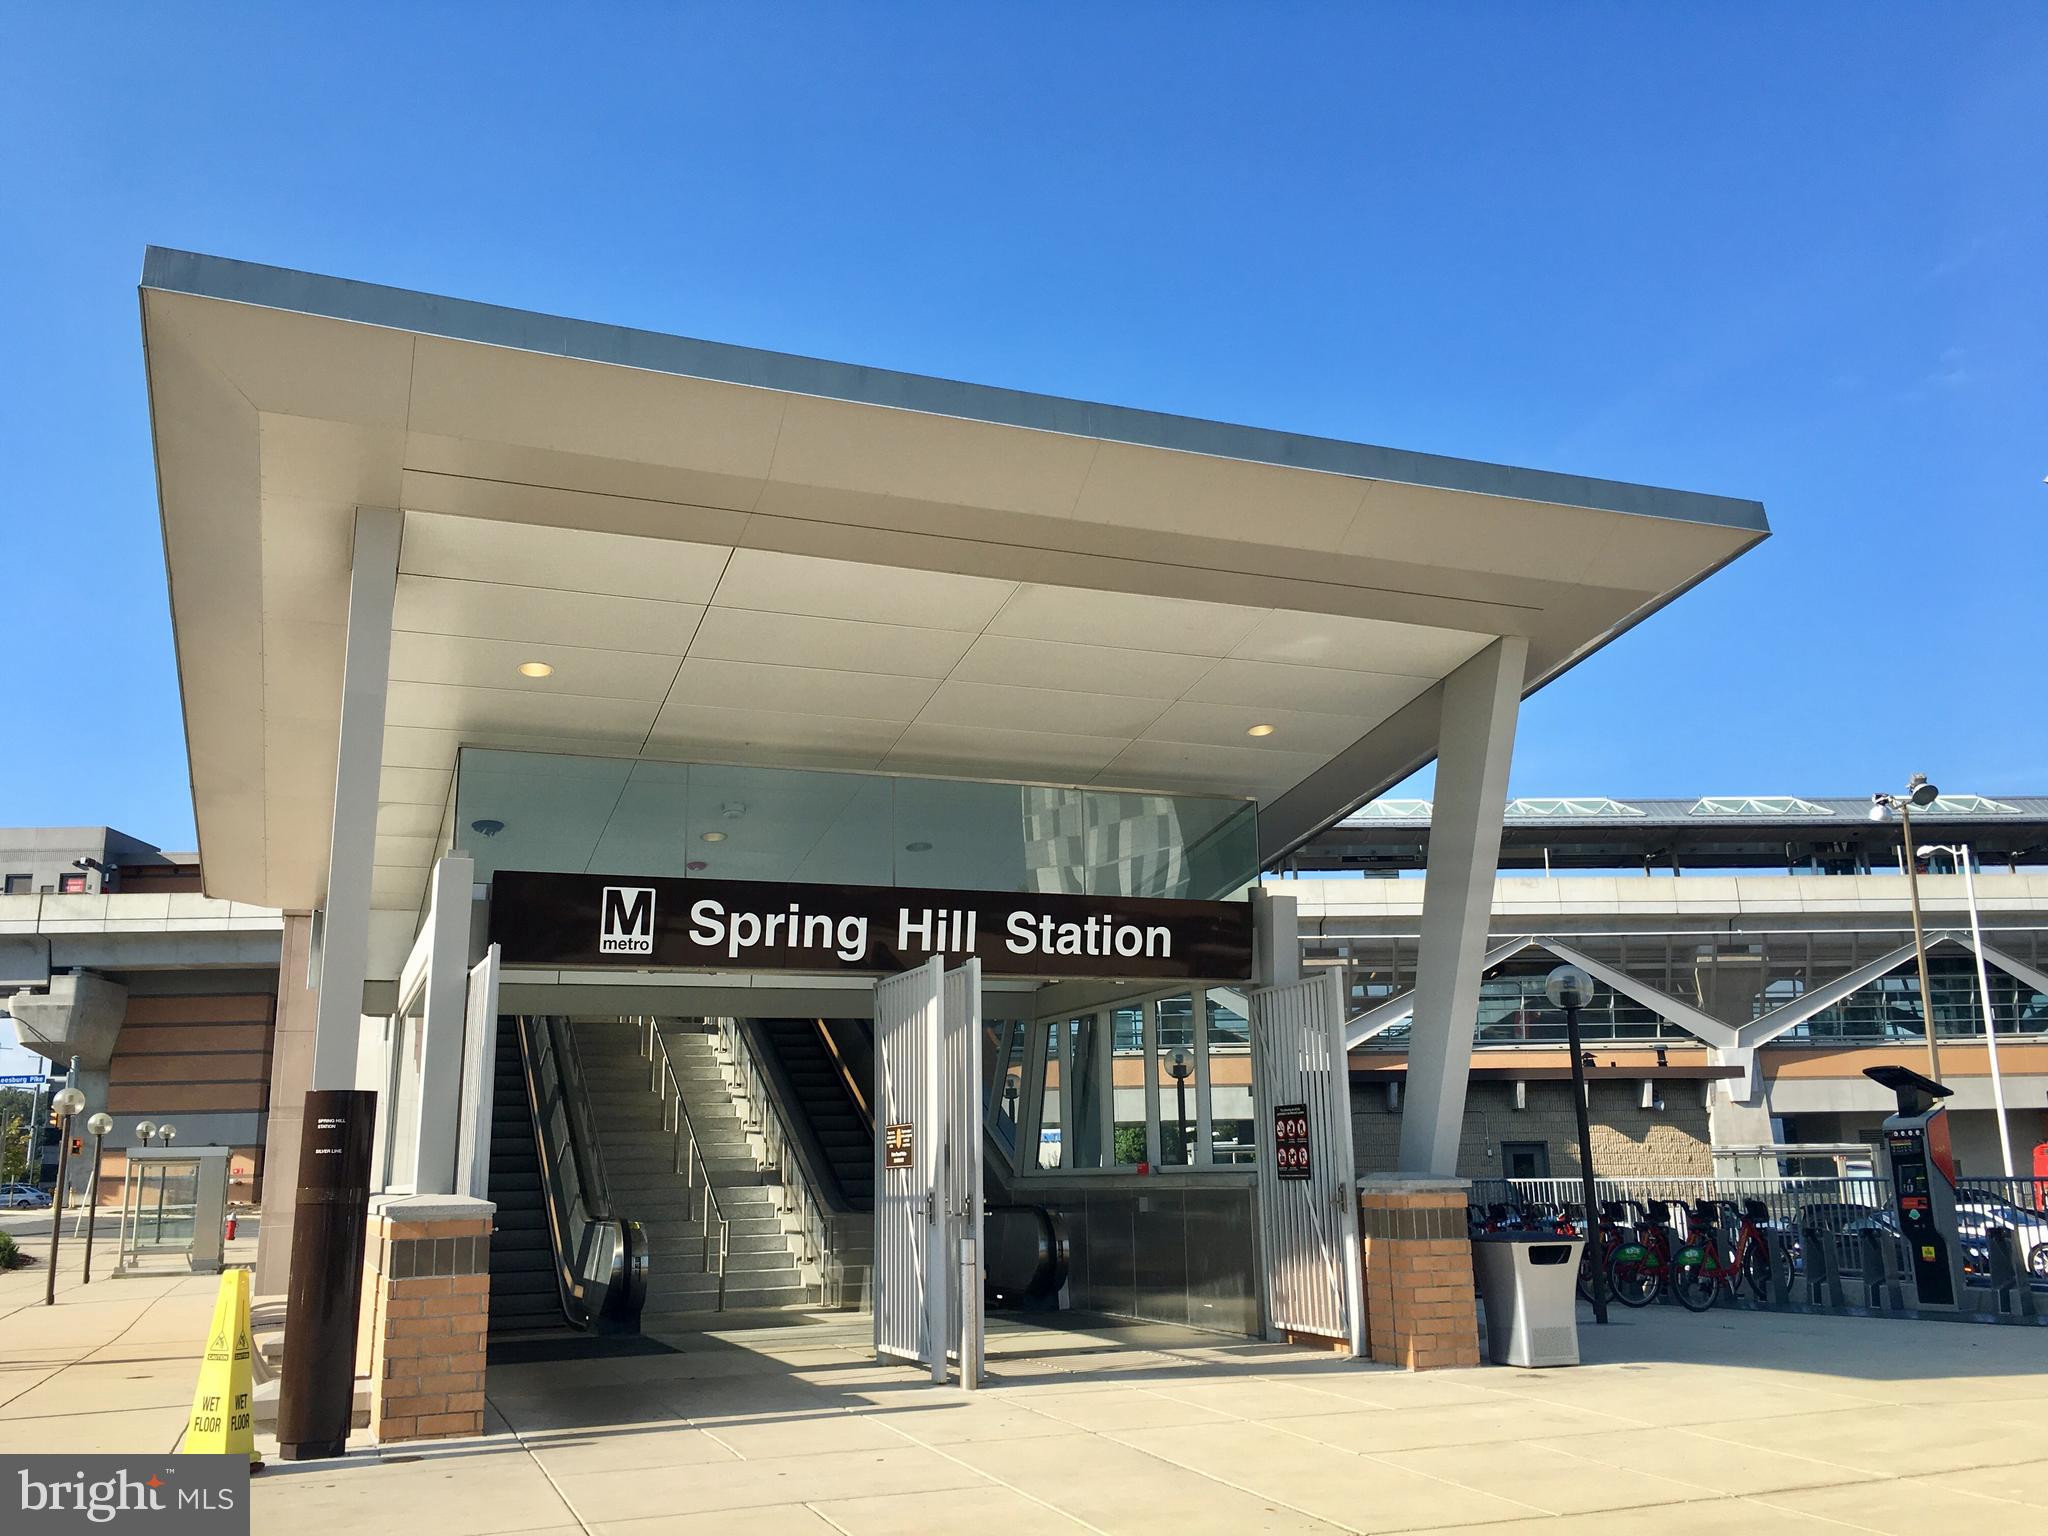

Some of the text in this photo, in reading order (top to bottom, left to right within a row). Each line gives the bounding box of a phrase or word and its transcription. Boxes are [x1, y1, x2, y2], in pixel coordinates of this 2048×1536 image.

[604, 889, 652, 936] M
[689, 899, 1171, 961] Spring Hill Station
[603, 937, 649, 951] metro
[202, 1396, 221, 1411] WET
[235, 1394, 248, 1410] WET
[194, 1416, 221, 1432] FLOOR
[231, 1413, 250, 1431] FLOOR
